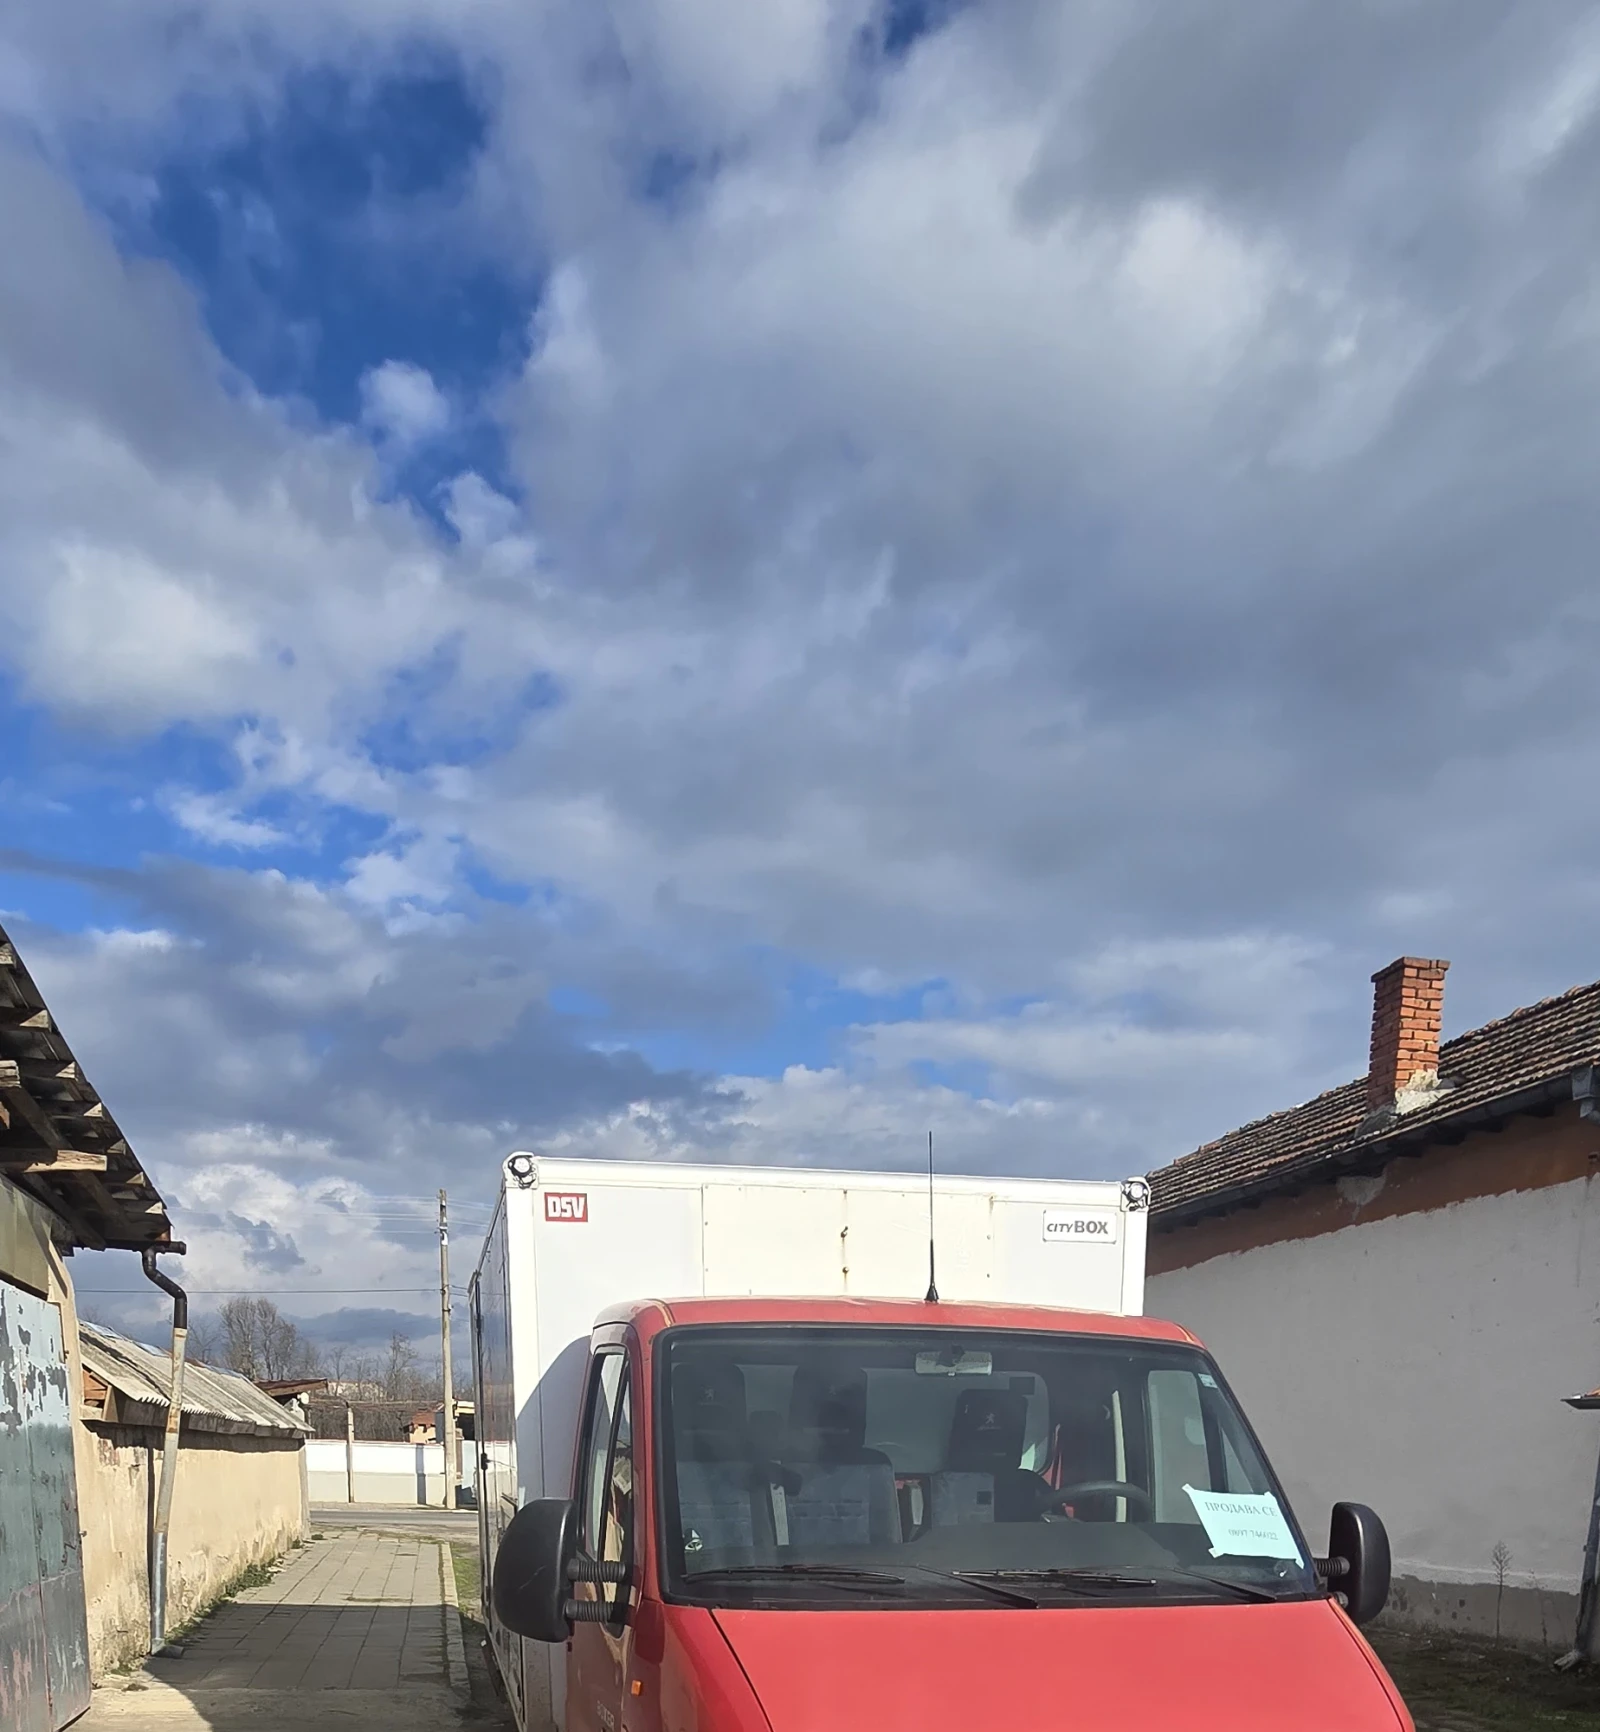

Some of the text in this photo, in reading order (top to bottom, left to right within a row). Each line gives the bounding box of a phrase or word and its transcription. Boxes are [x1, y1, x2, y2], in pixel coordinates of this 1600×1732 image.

[547, 1195, 586, 1218] DSV
[1204, 1501, 1278, 1517] ПРОДАВА СЕ
